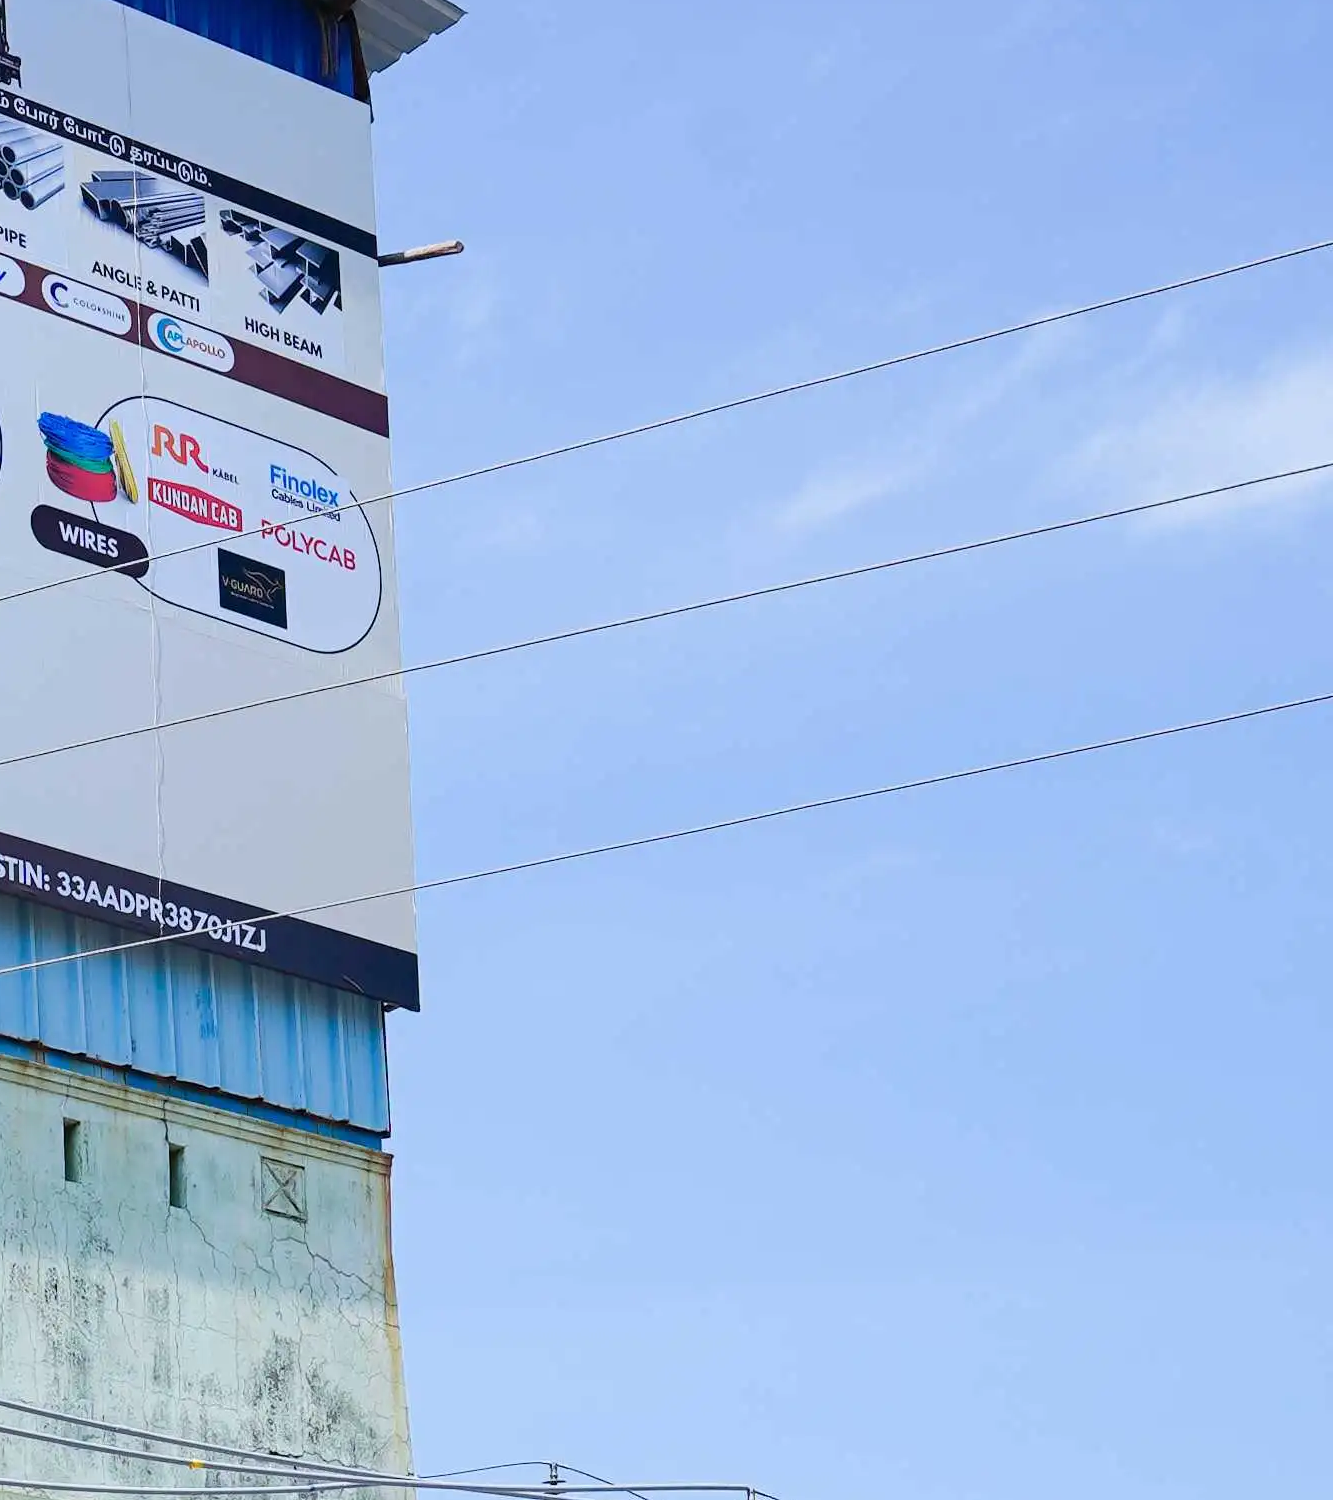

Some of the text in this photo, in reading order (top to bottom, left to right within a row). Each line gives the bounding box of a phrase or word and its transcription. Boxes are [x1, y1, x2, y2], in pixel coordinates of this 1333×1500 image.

[92, 261, 200, 312] ANGLE & PATTI
[245, 316, 323, 359] HIGH BEAM
[152, 480, 238, 529] KUNDAN CAB
[270, 464, 340, 508] Finolex
[271, 488, 303, 510] Cables
[58, 520, 119, 559] WIRES
[261, 519, 357, 571] POLYCAB
